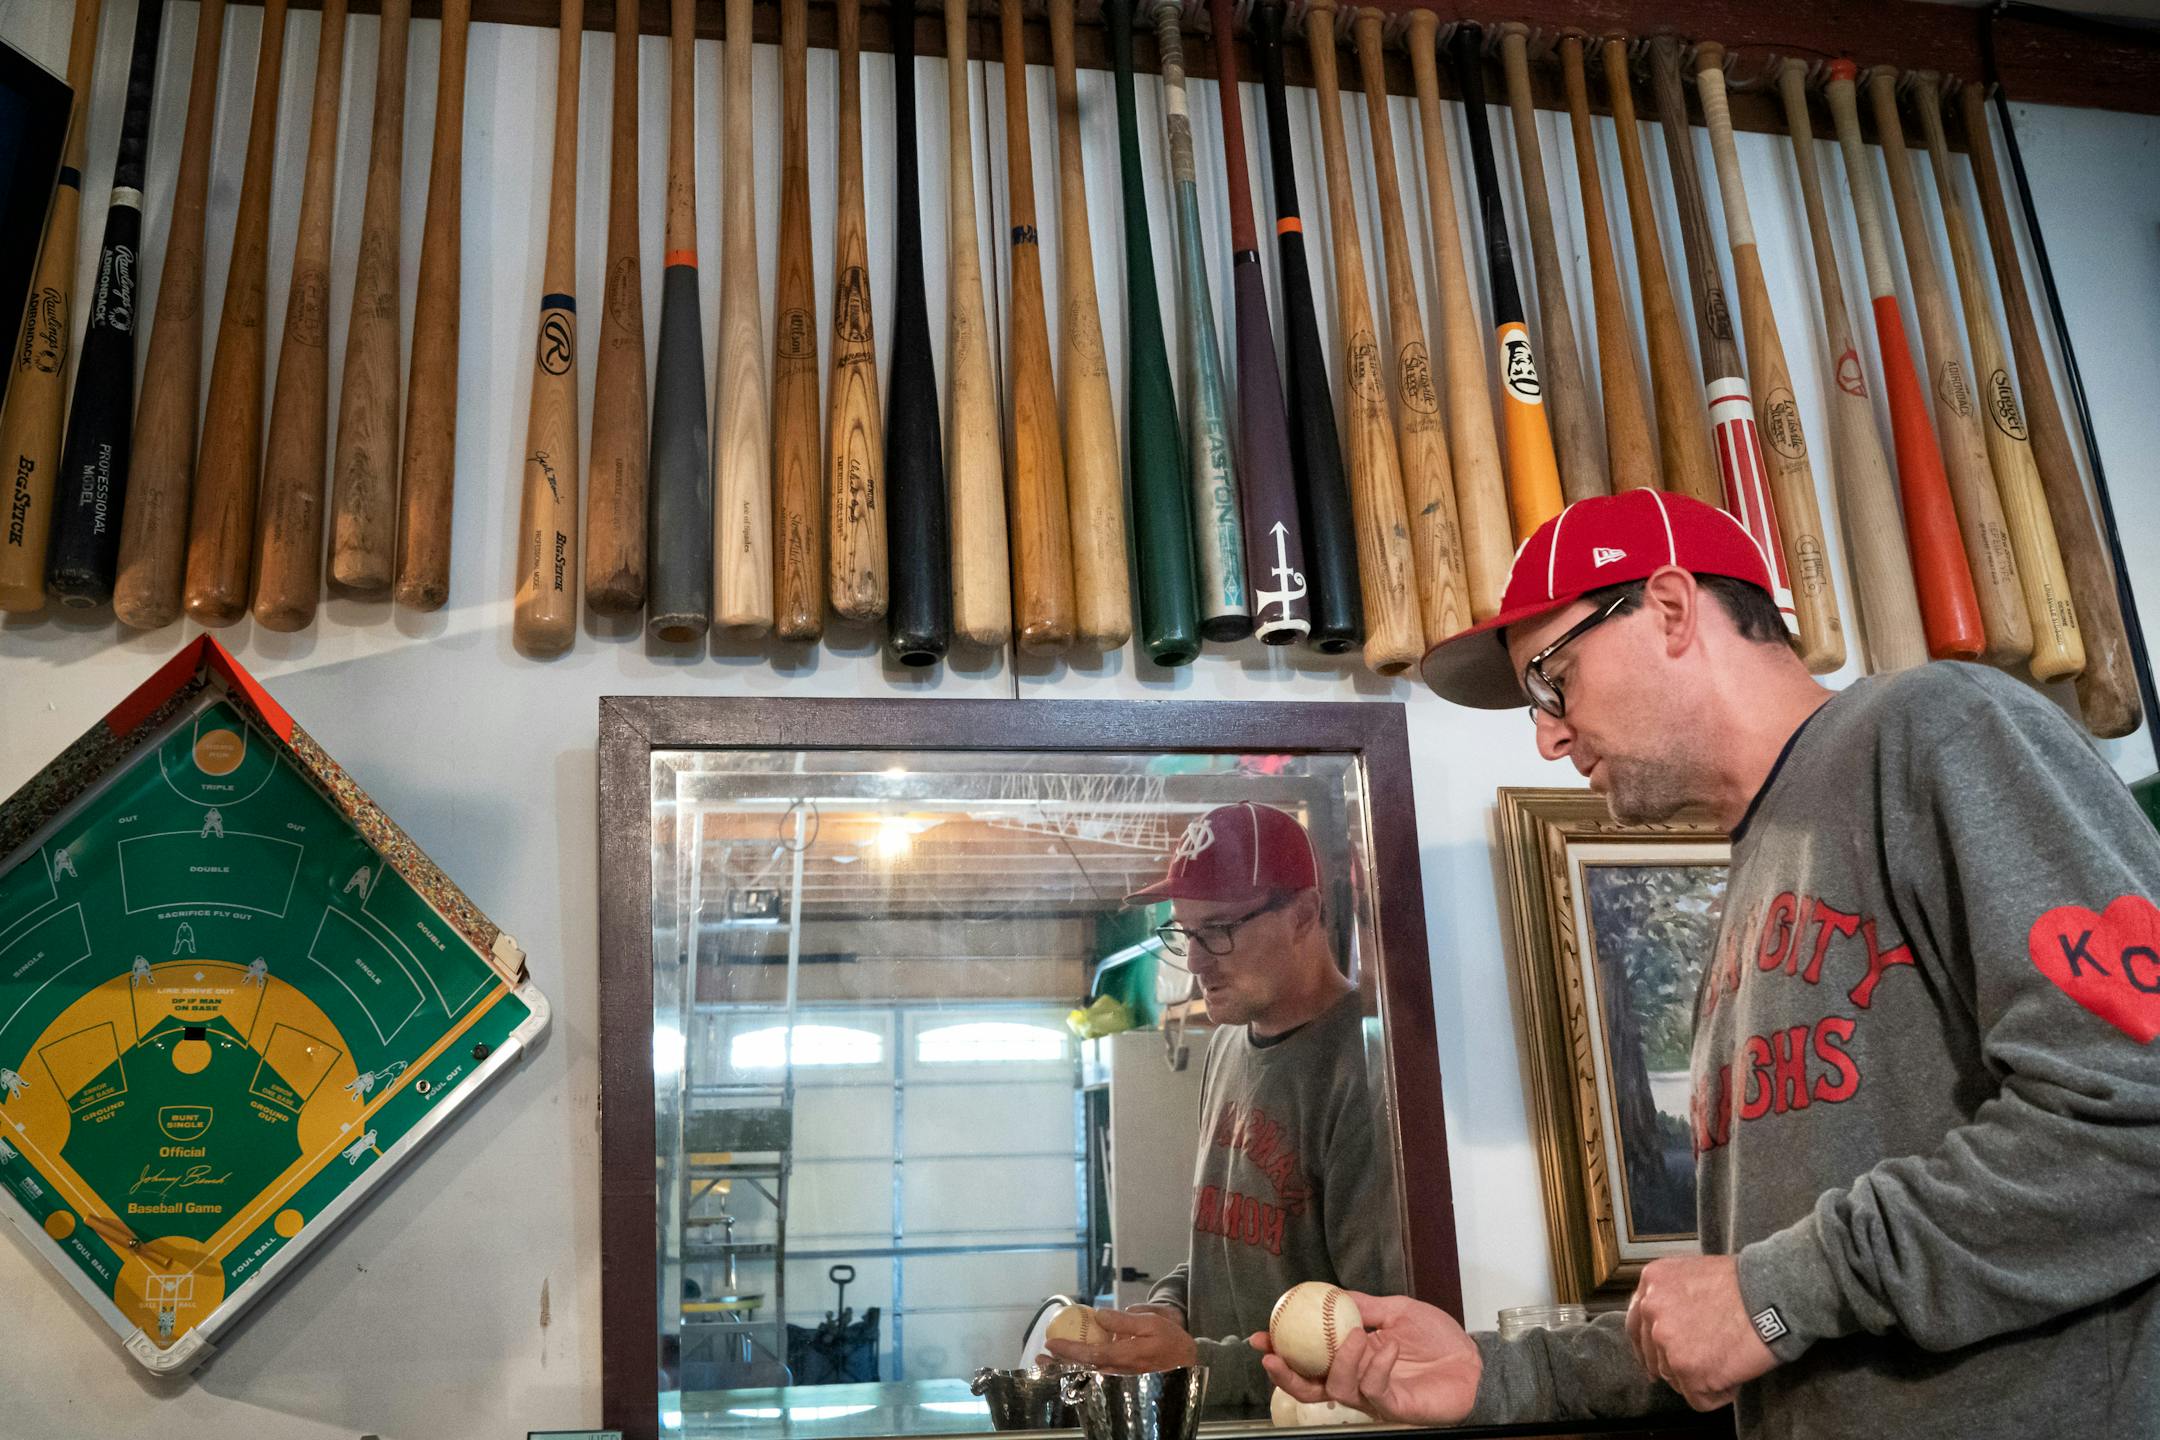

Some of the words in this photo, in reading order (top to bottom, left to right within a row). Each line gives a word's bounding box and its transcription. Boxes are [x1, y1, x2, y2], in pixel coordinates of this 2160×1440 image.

[95, 249, 113, 321] ADIRONDACK
[112, 245, 135, 308] Rawlings
[22, 293, 39, 366] ADIRONDACK
[40, 287, 62, 350] Rawlings
[791, 314, 806, 353] Wilson
[1946, 360, 1969, 417] ADIRONDACK
[1995, 374, 2024, 433] Slugger
[80, 464, 95, 507] MODEL
[94, 443, 112, 535] PROFESSIONAL
[1206, 417, 1234, 525] EASTON
[118, 815, 138, 824] OUT
[287, 822, 306, 832] OUT
[158, 910, 211, 920] SACRIFICE
[214, 910, 231, 918] FLY
[233, 912, 252, 921] OUT
[416, 921, 446, 952] DOUBLE
[1758, 891, 1916, 1010] CITY
[12, 951, 45, 979] SINGLE
[355, 958, 383, 985] SINGLE
[2058, 929, 2160, 994] KC
[425, 1081, 446, 1101] FOUL
[446, 1065, 463, 1082] OUT
[82, 1101, 125, 1122] GROUND
[96, 1111, 117, 1123] OUT
[250, 1101, 289, 1122] GROUND
[258, 1112, 277, 1124] OUT
[159, 1146, 206, 1158] Official
[129, 1164, 183, 1199] Johnny
[128, 1203, 182, 1214] Baseball
[185, 1203, 222, 1214] Game
[71, 1238, 92, 1261] FOUL
[91, 1259, 109, 1280] BALL
[231, 1256, 255, 1279] FOUL
[255, 1237, 277, 1257] BALL
